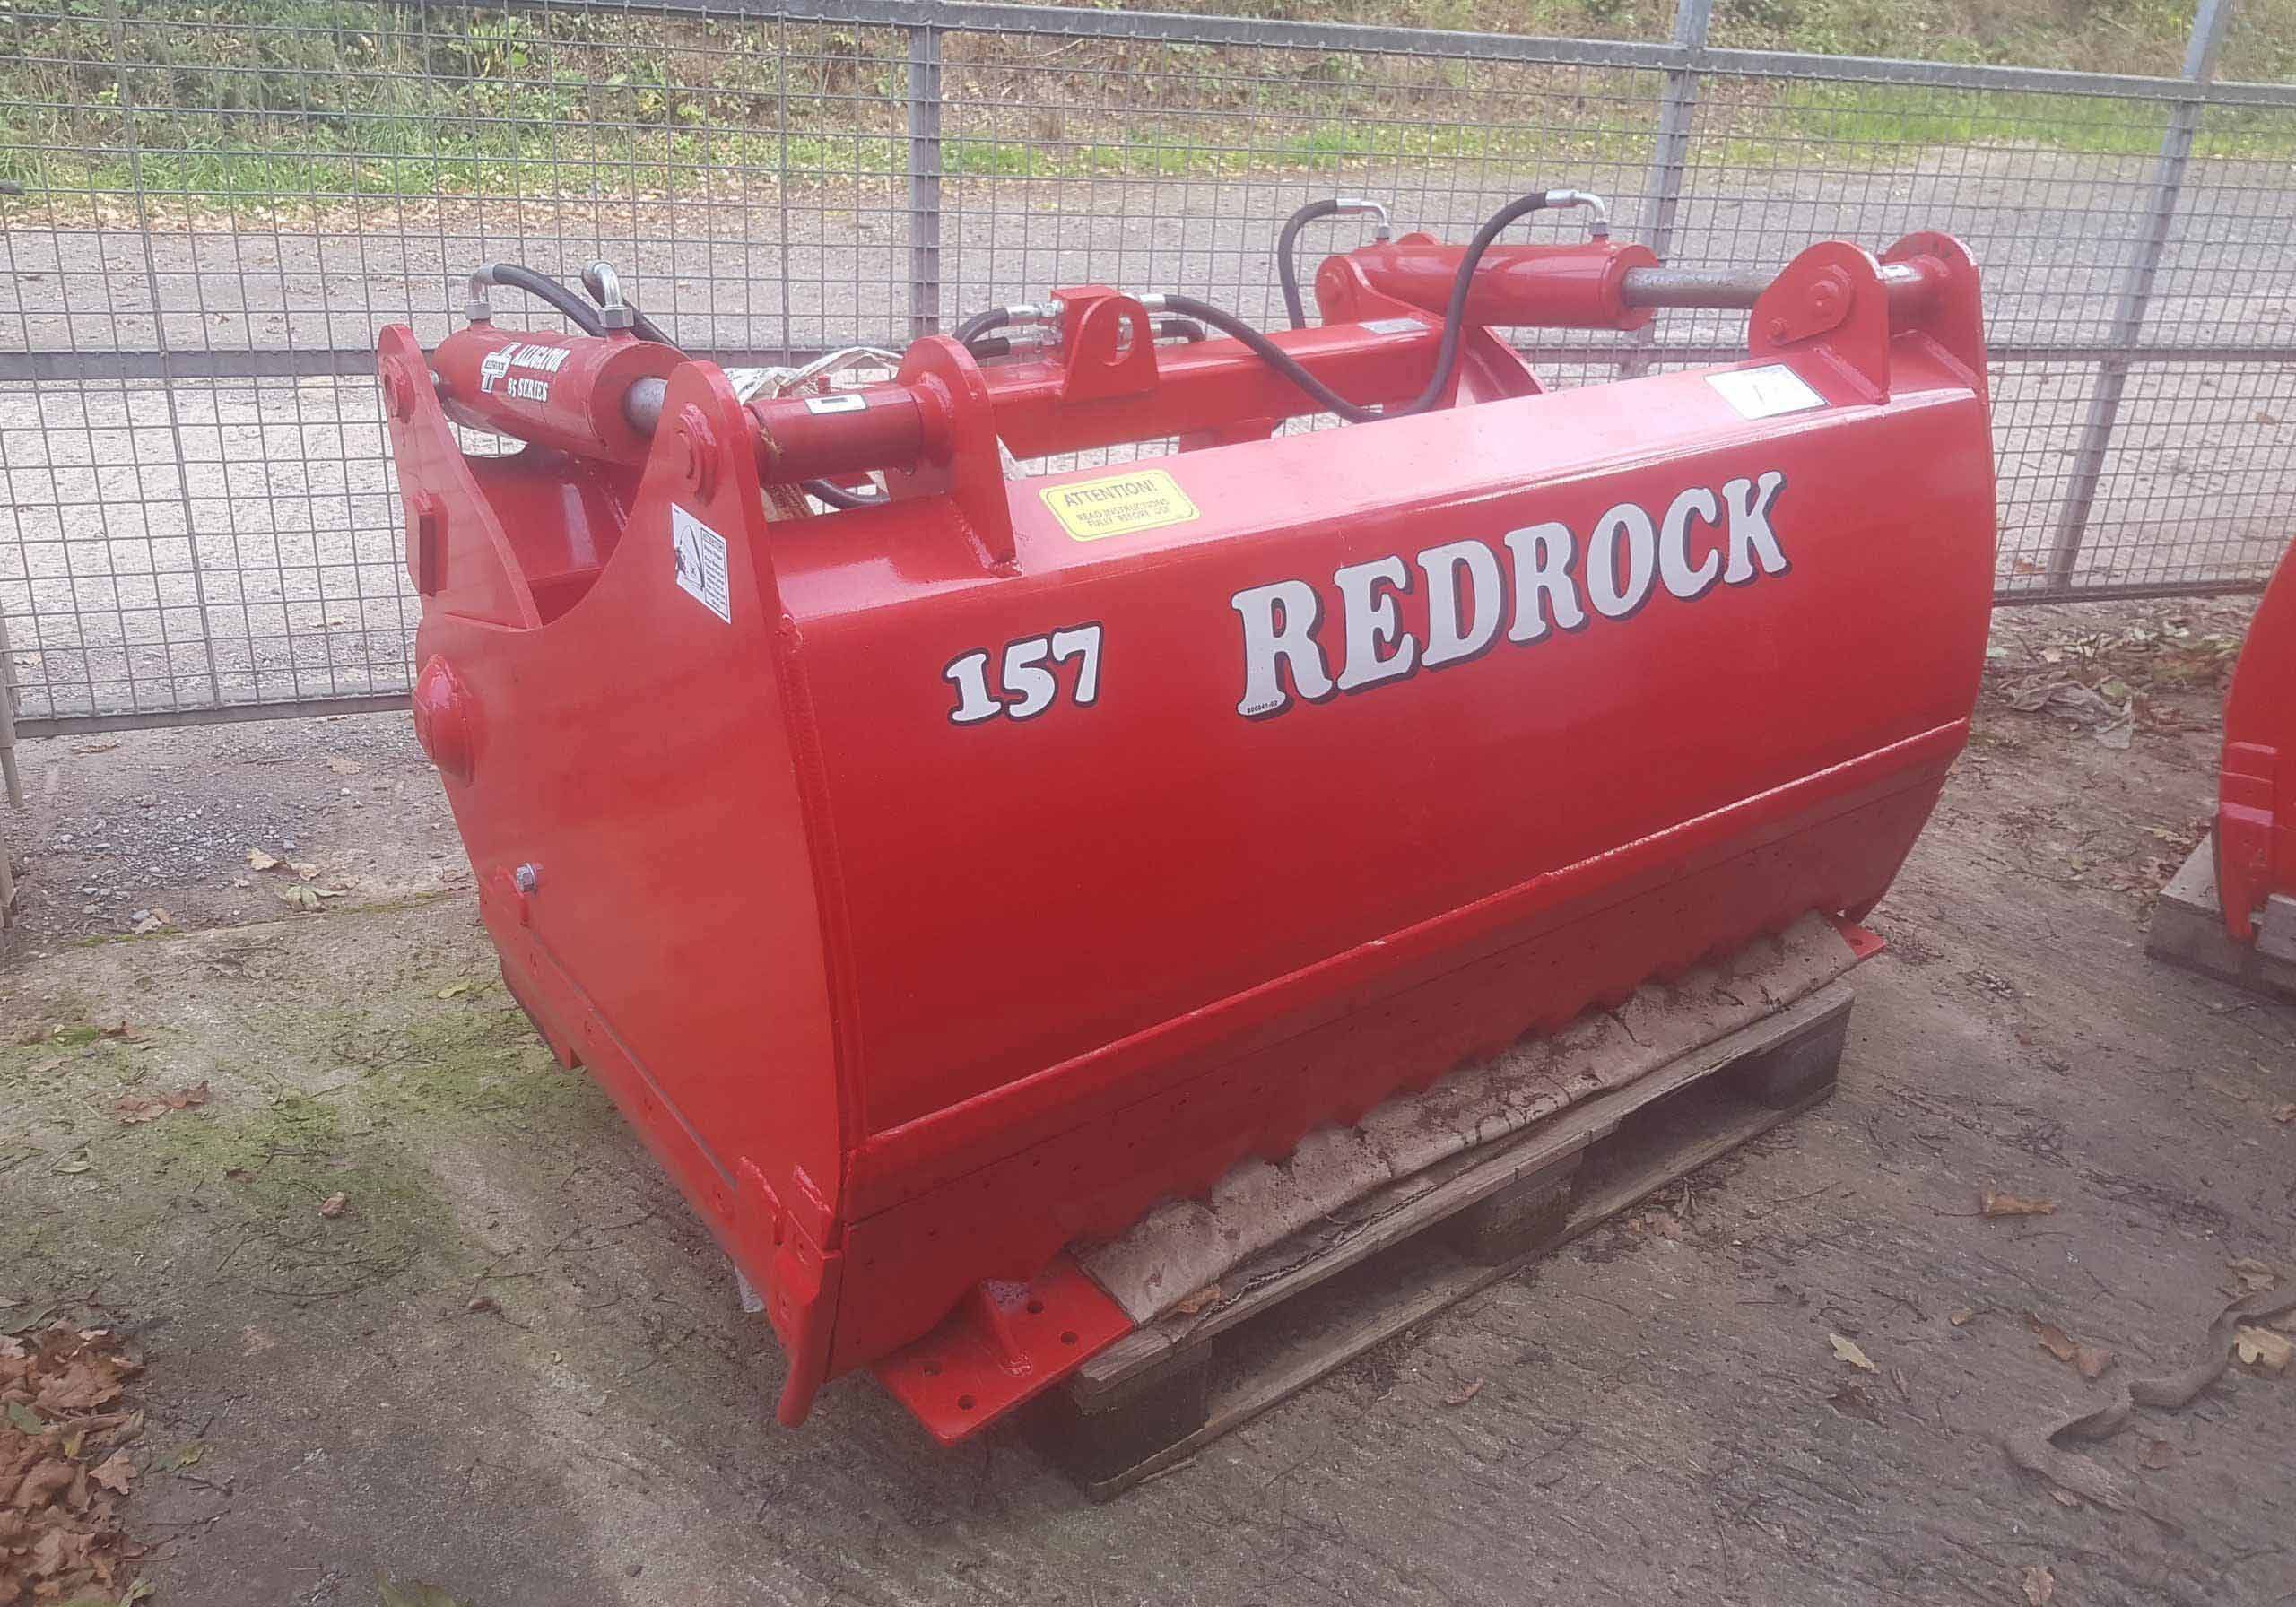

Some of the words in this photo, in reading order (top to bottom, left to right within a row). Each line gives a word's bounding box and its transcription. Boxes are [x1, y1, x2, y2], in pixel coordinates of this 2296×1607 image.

[517, 378, 549, 403] SERIES
[1064, 479, 1158, 507] ATTENTION!
[1075, 509, 1103, 521] READ
[1103, 498, 1170, 517] INSTRUCTIONS
[1231, 470, 1790, 720] REDROCK
[942, 620, 1104, 726] 157
